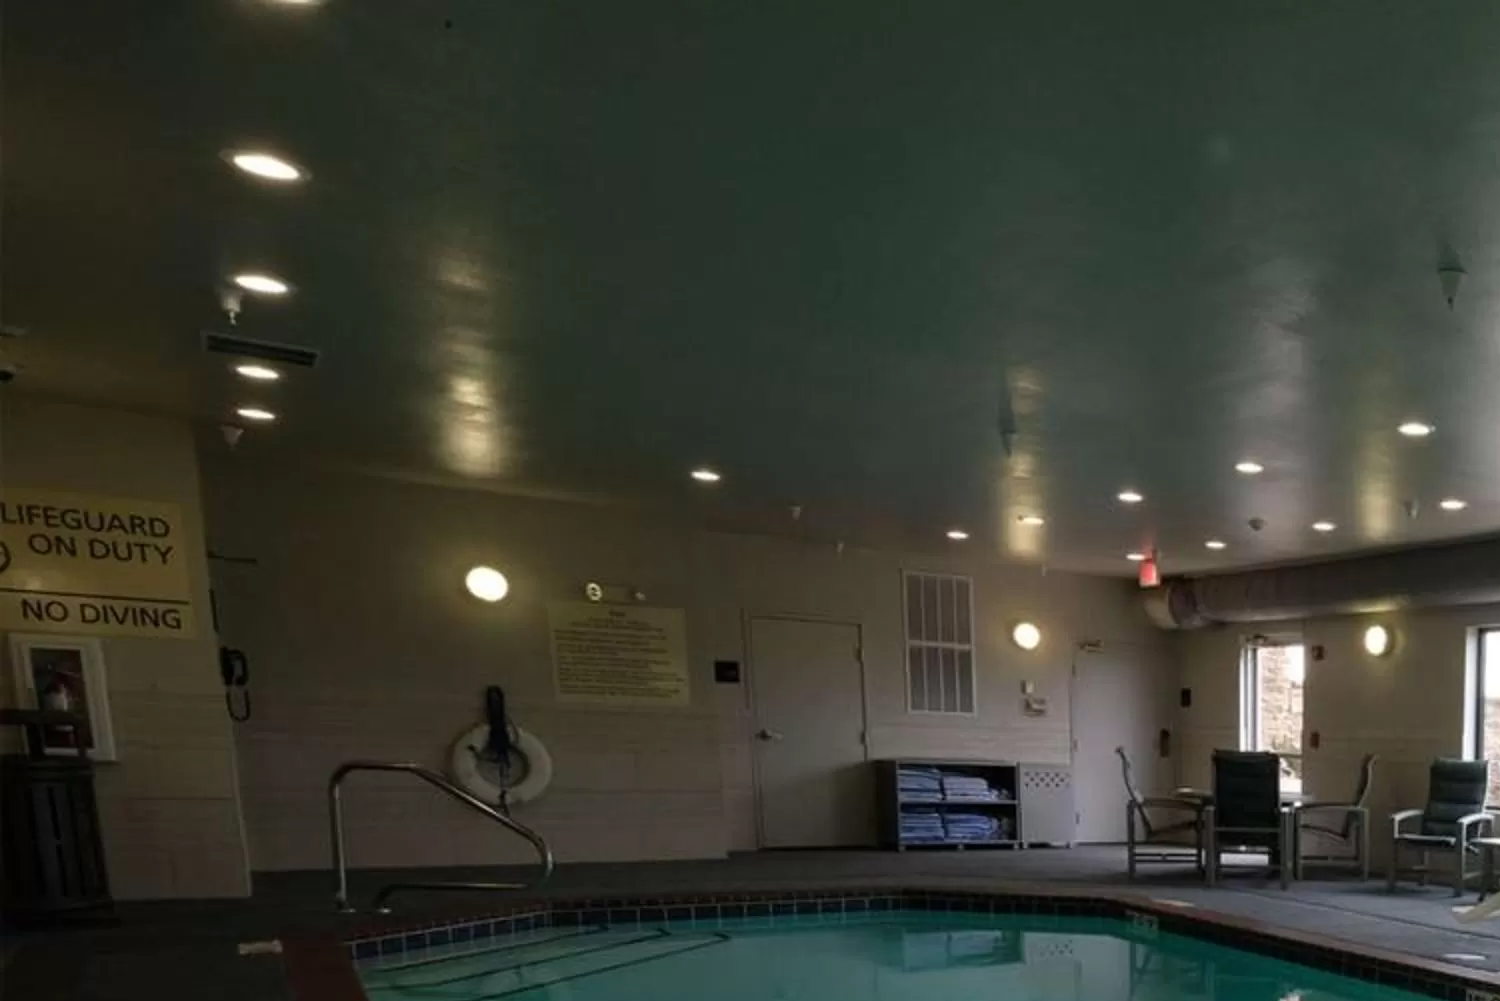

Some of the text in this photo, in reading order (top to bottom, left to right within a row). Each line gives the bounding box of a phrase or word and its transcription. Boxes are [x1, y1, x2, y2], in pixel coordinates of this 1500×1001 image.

[0, 502, 171, 538] LIFEGUARD
[27, 533, 174, 565] ON DUTY
[21, 599, 182, 630] NO DIVING
